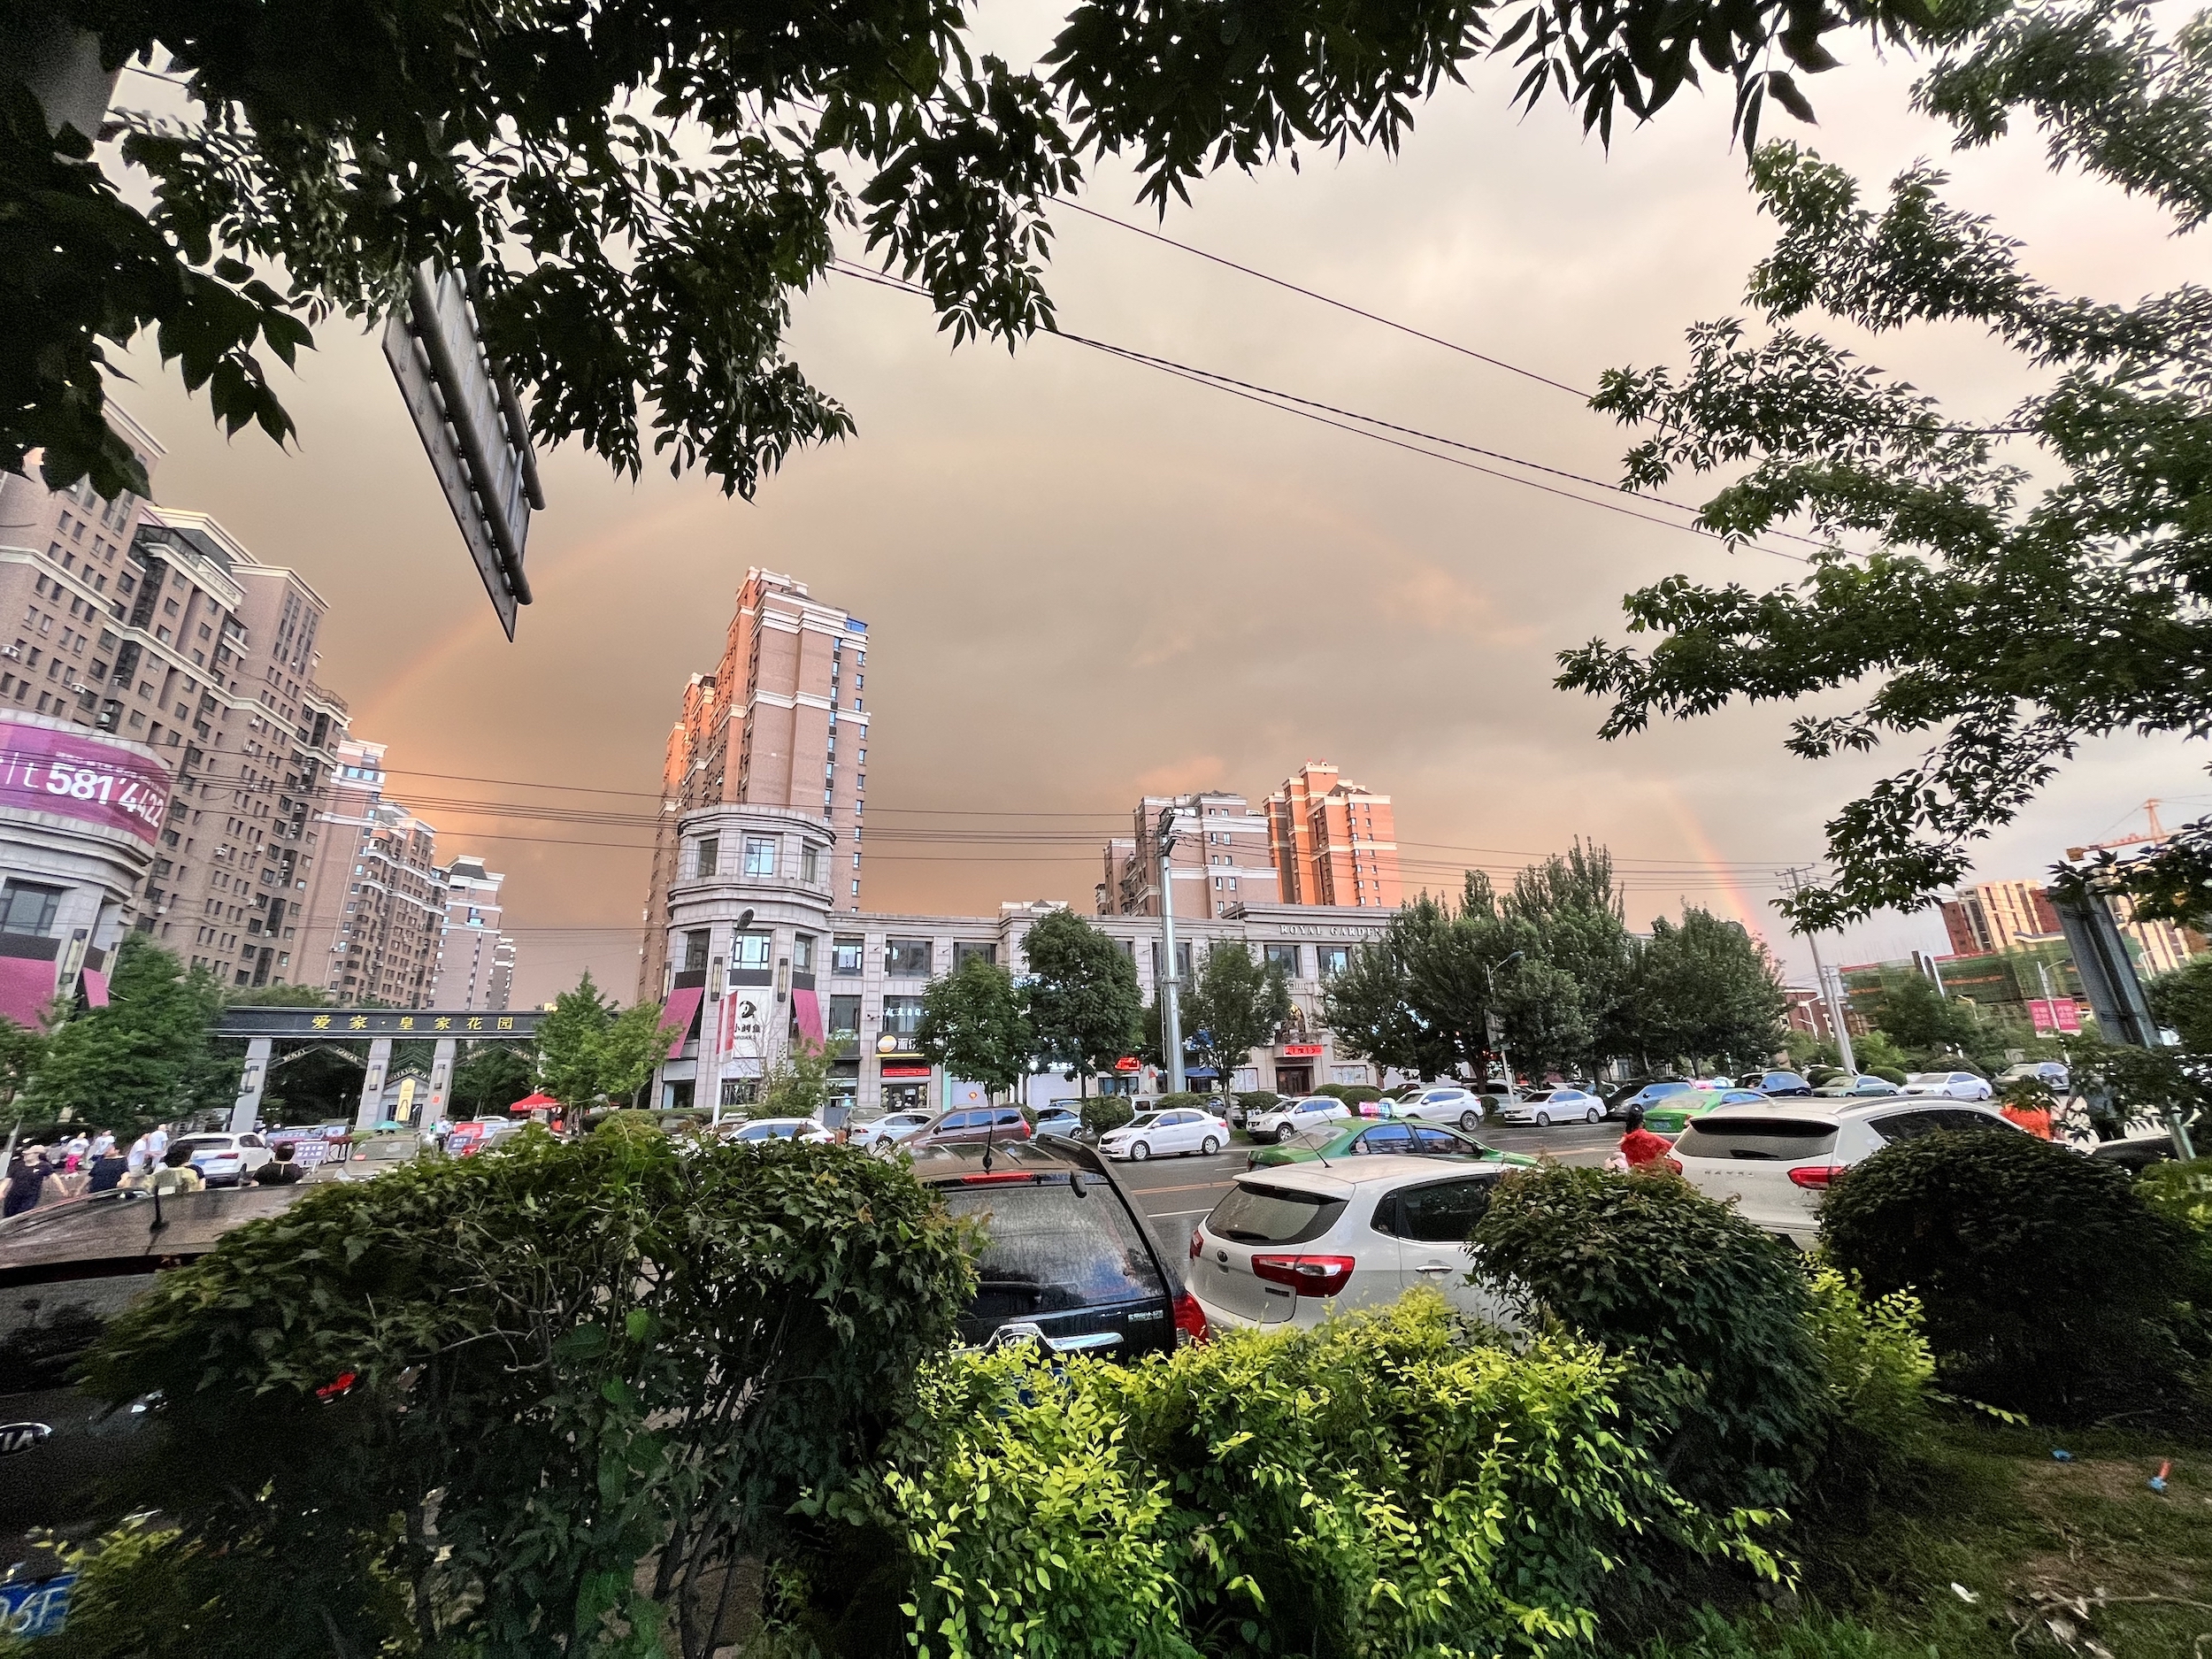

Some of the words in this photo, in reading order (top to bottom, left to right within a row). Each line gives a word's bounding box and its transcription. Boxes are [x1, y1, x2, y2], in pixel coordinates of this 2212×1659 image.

[1279, 925, 1322, 936] ROYAL
[1330, 927, 1382, 937] GARDEN
[311, 1015, 514, 1030] 爱家·皇家花园
